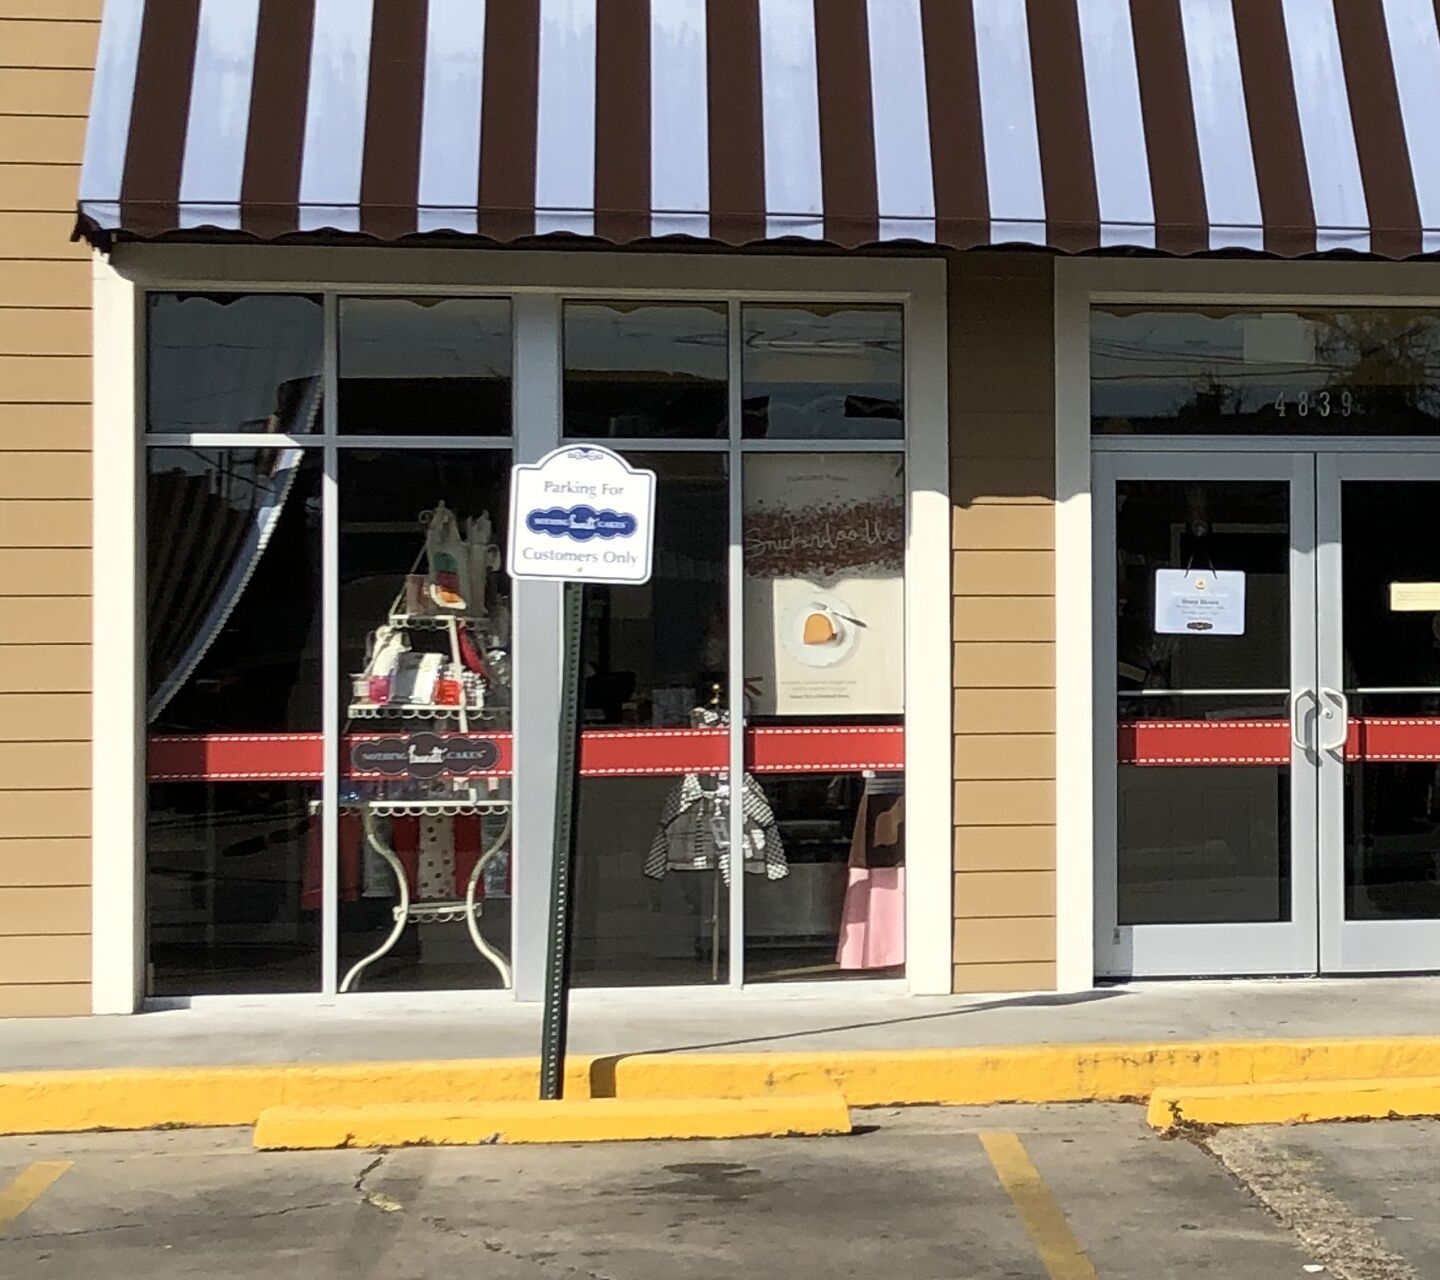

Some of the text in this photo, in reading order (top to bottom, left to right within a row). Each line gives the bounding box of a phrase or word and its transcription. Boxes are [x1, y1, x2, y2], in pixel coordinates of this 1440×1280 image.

[1274, 391, 1352, 417] 4839
[543, 480, 625, 499] Parking For
[522, 547, 639, 568] Customers Only
